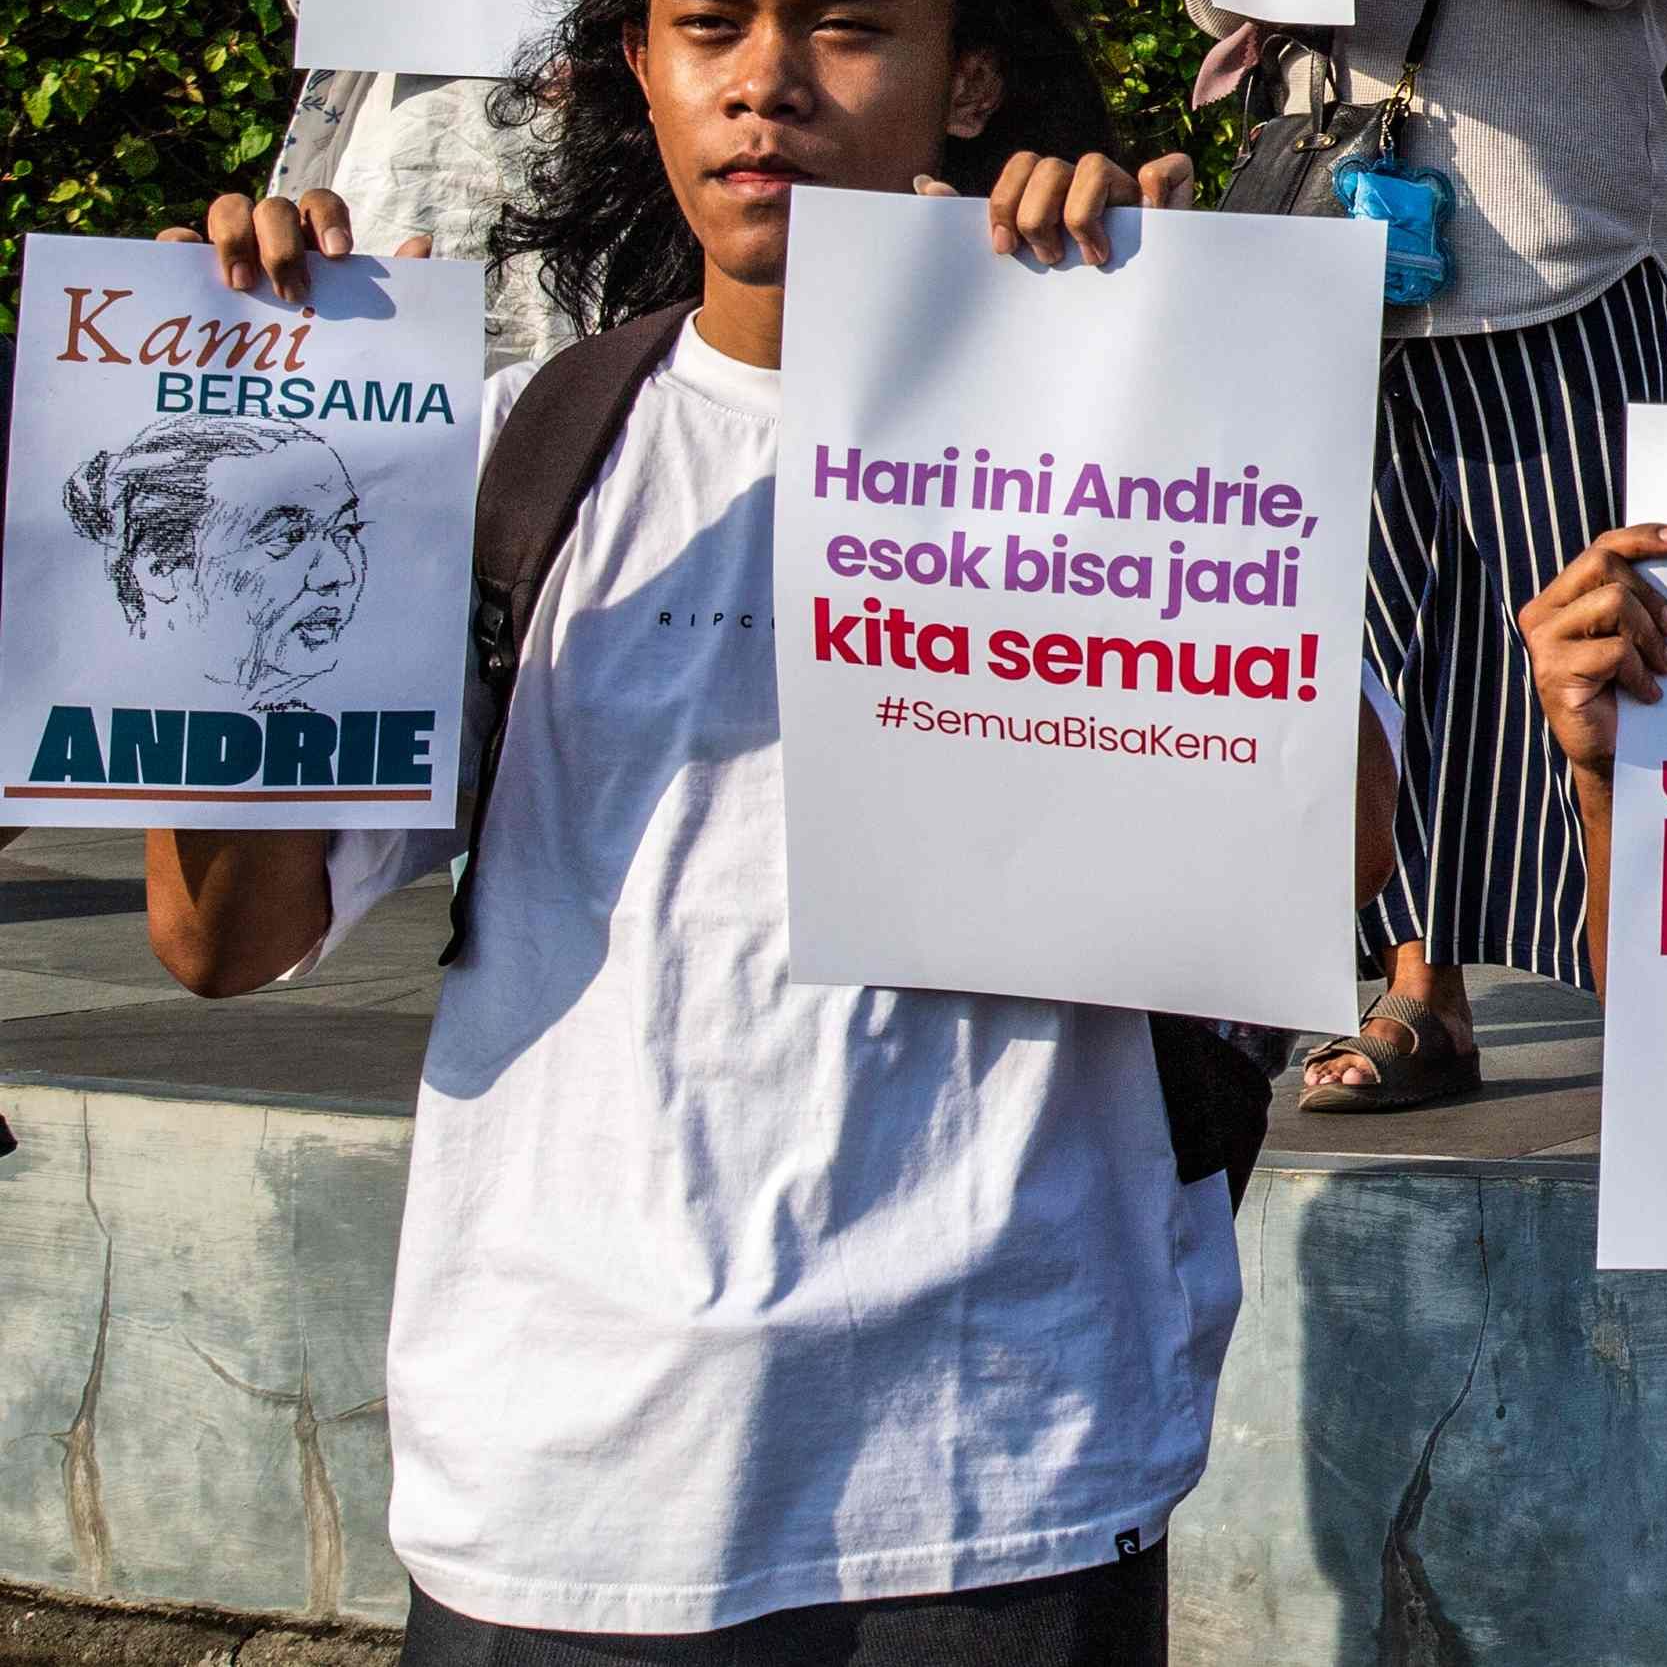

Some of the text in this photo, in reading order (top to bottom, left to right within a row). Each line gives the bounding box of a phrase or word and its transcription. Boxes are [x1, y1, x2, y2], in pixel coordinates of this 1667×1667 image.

[57, 287, 316, 372] Kami
[156, 372, 455, 424] BERSAMA
[814, 445, 1319, 538] Hari ini Andrie,
[827, 531, 1299, 620] esok bisa jadi
[814, 596, 1320, 702] kita semua!
[28, 705, 435, 786] ANDRIE
[876, 695, 1258, 764] #SemuaBisaKena
